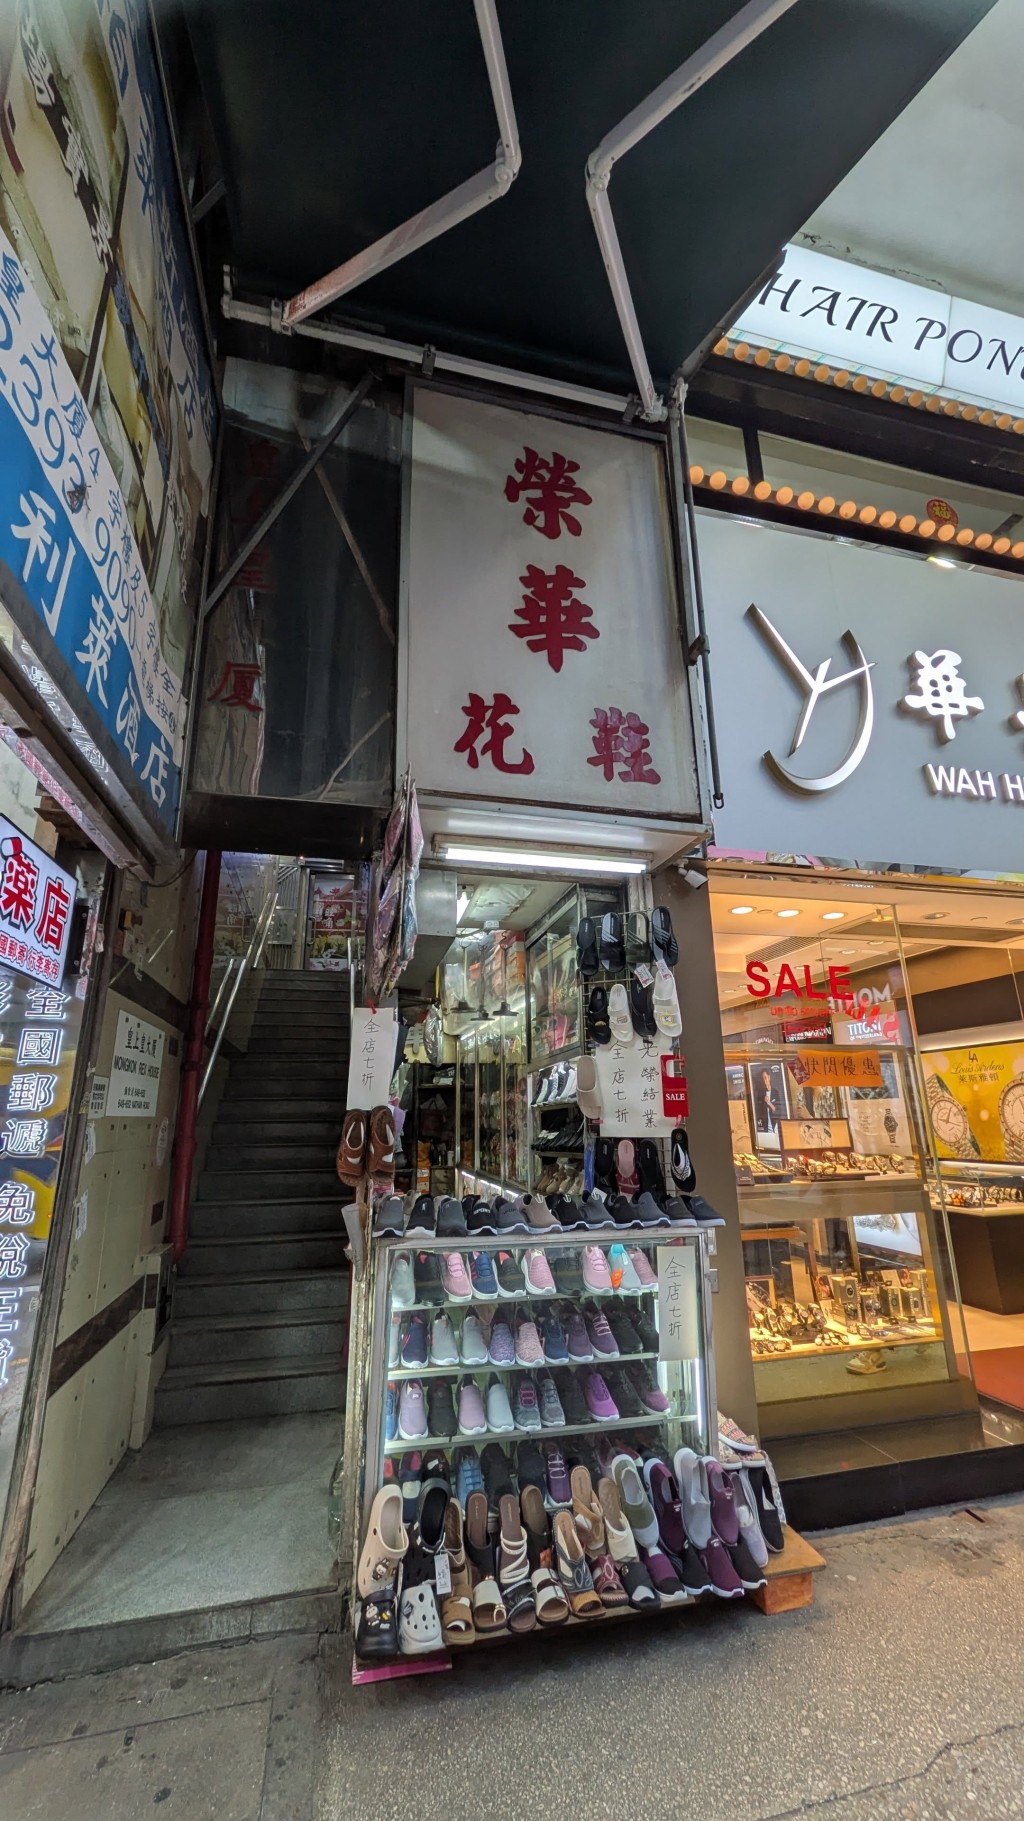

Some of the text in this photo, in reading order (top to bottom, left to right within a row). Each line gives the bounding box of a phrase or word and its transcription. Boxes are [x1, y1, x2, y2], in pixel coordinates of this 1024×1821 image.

[758, 272, 1024, 381] HAIR PON
[92, 517, 138, 651] 9090
[504, 447, 600, 673] 榮華
[926, 763, 1024, 801] WAH H
[746, 961, 853, 1000] SALE
[114, 1055, 137, 1074] MONGKOK
[361, 1018, 381, 1092] 全店七折
[610, 1041, 629, 1123] 全店七折
[804, 1056, 879, 1076] 快閃優惠
[665, 1092, 686, 1101] SALE
[664, 1256, 686, 1341] 全店七折
